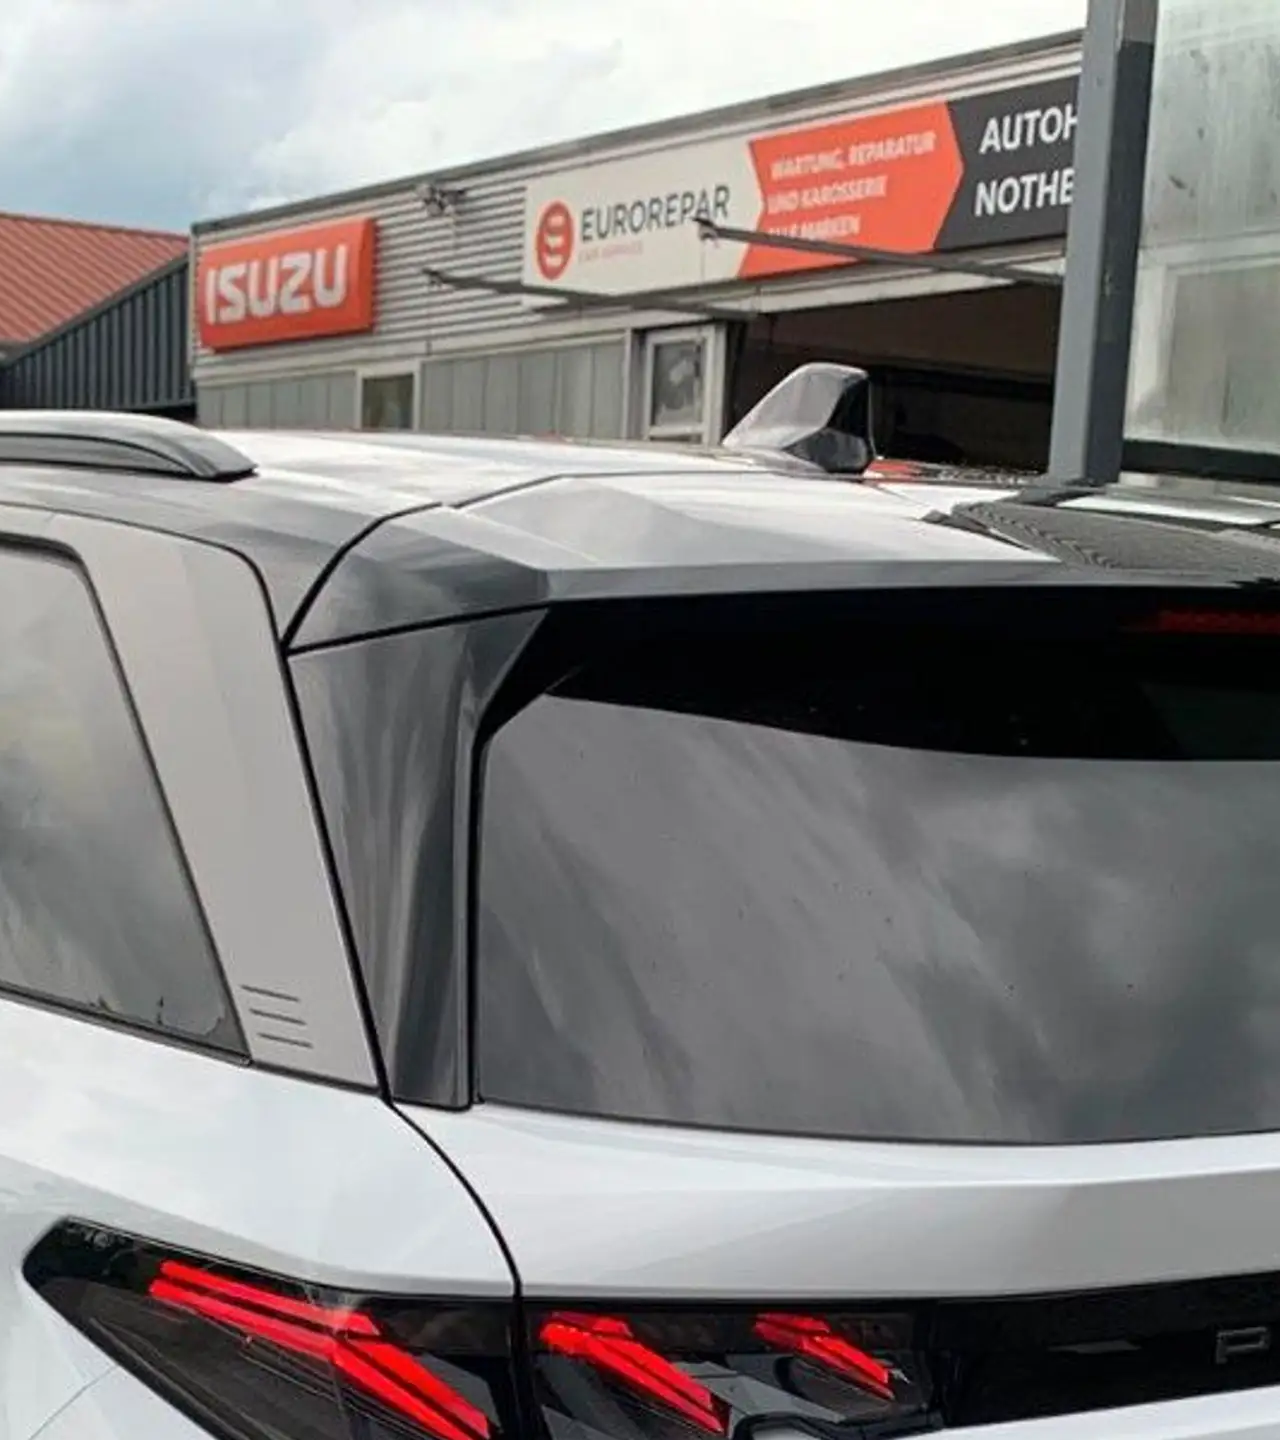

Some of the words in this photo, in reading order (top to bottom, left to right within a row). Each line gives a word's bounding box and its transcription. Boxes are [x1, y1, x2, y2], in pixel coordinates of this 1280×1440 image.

[848, 130, 937, 165] REPARATUR
[581, 184, 731, 243] EUROREPAR
[204, 243, 350, 326] ISUZU
